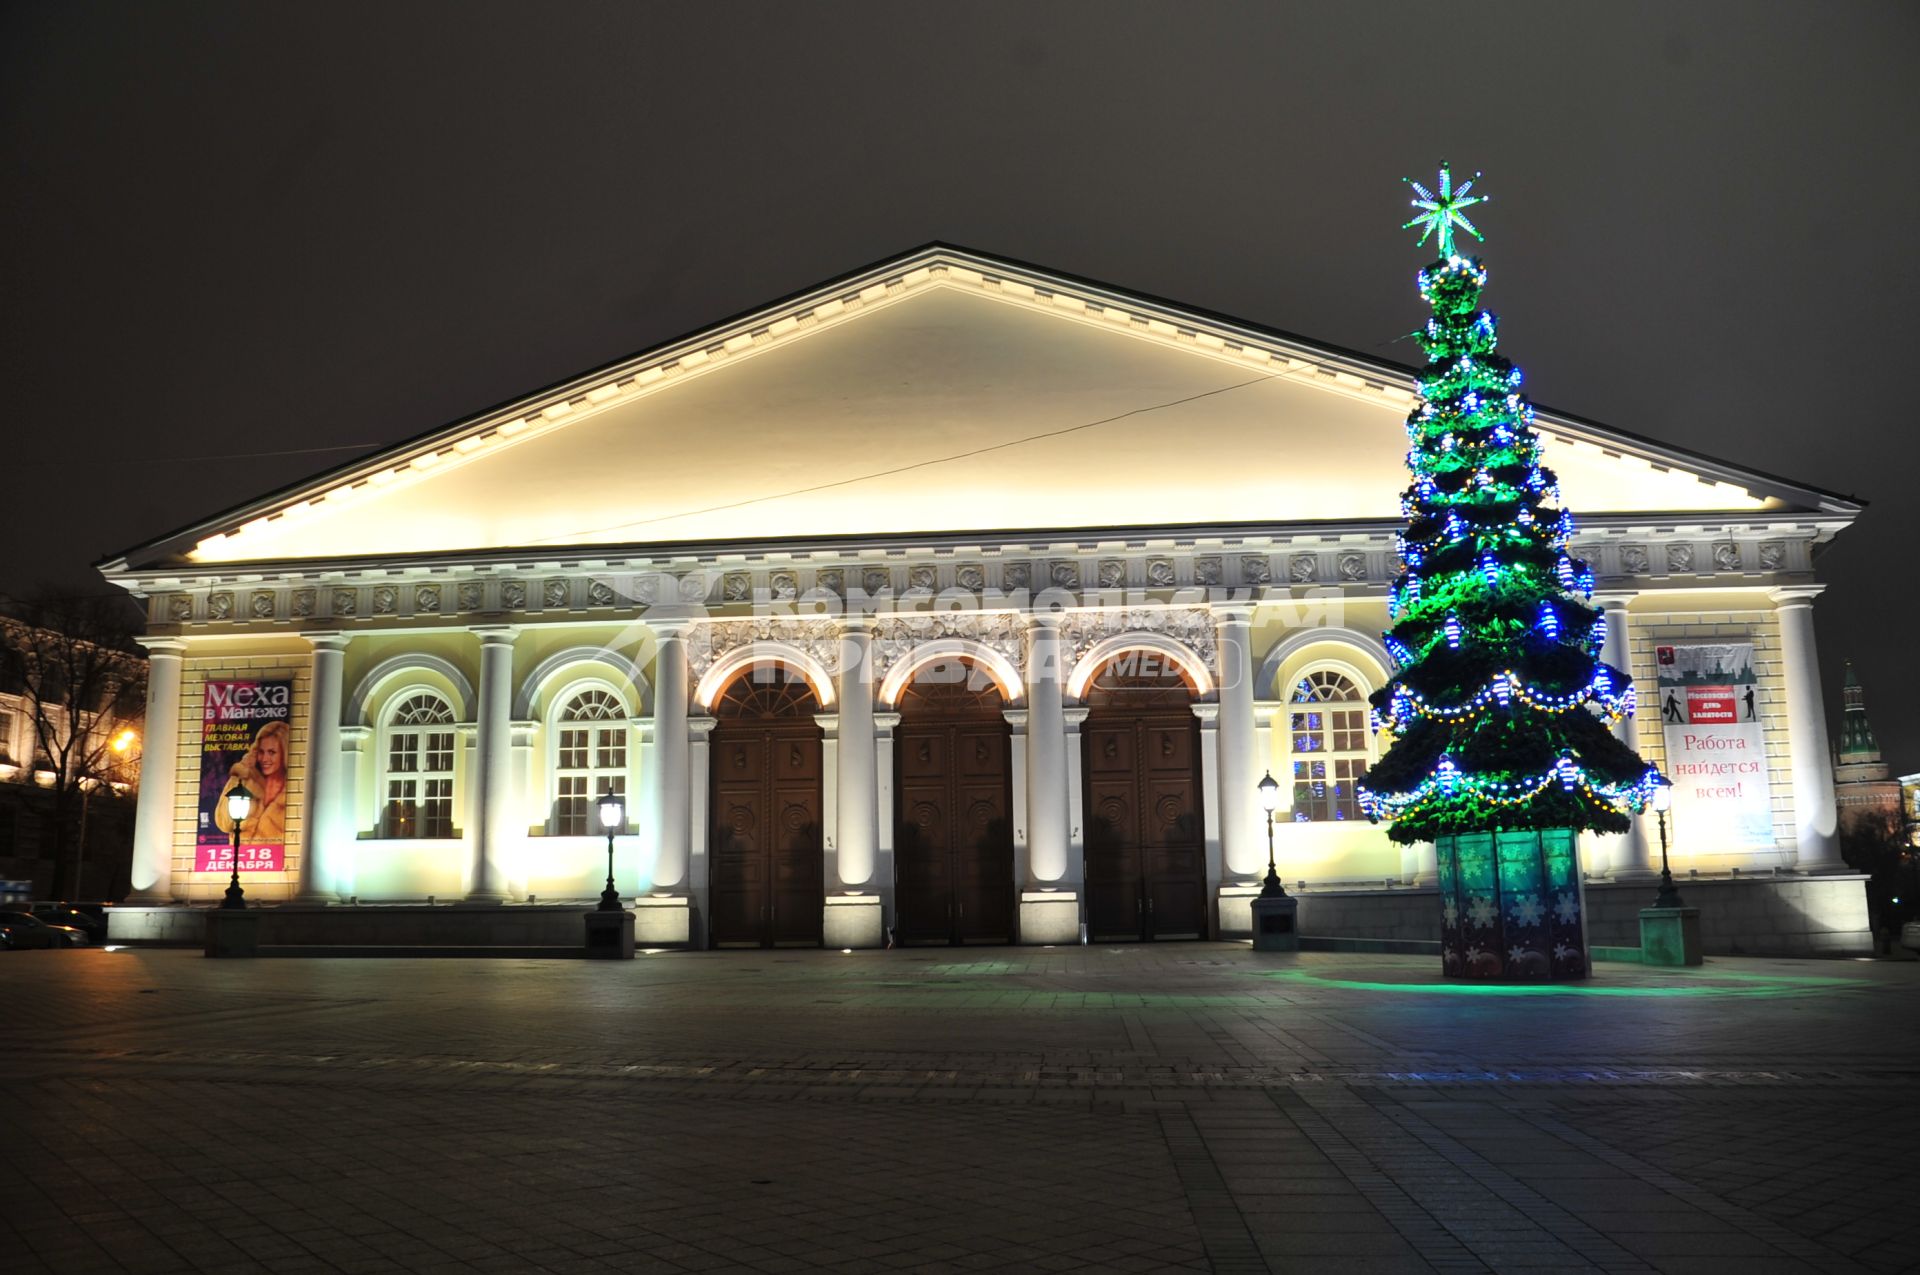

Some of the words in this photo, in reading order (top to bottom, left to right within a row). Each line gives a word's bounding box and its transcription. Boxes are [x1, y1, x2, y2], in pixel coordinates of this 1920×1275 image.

[206, 684, 289, 707] Меха
[205, 708, 216, 719] в
[220, 706, 288, 719] Манеже
[204, 723, 248, 732] ГЛАВНАЯ
[204, 733, 250, 742] МЕХОВАЯ
[1684, 734, 1746, 751] Работа
[204, 743, 250, 752] ВЫСТАВКА
[1675, 760, 1760, 776] найдется
[1696, 782, 1742, 800] всем!
[205, 860, 274, 871] ДЕКАБРЯ
